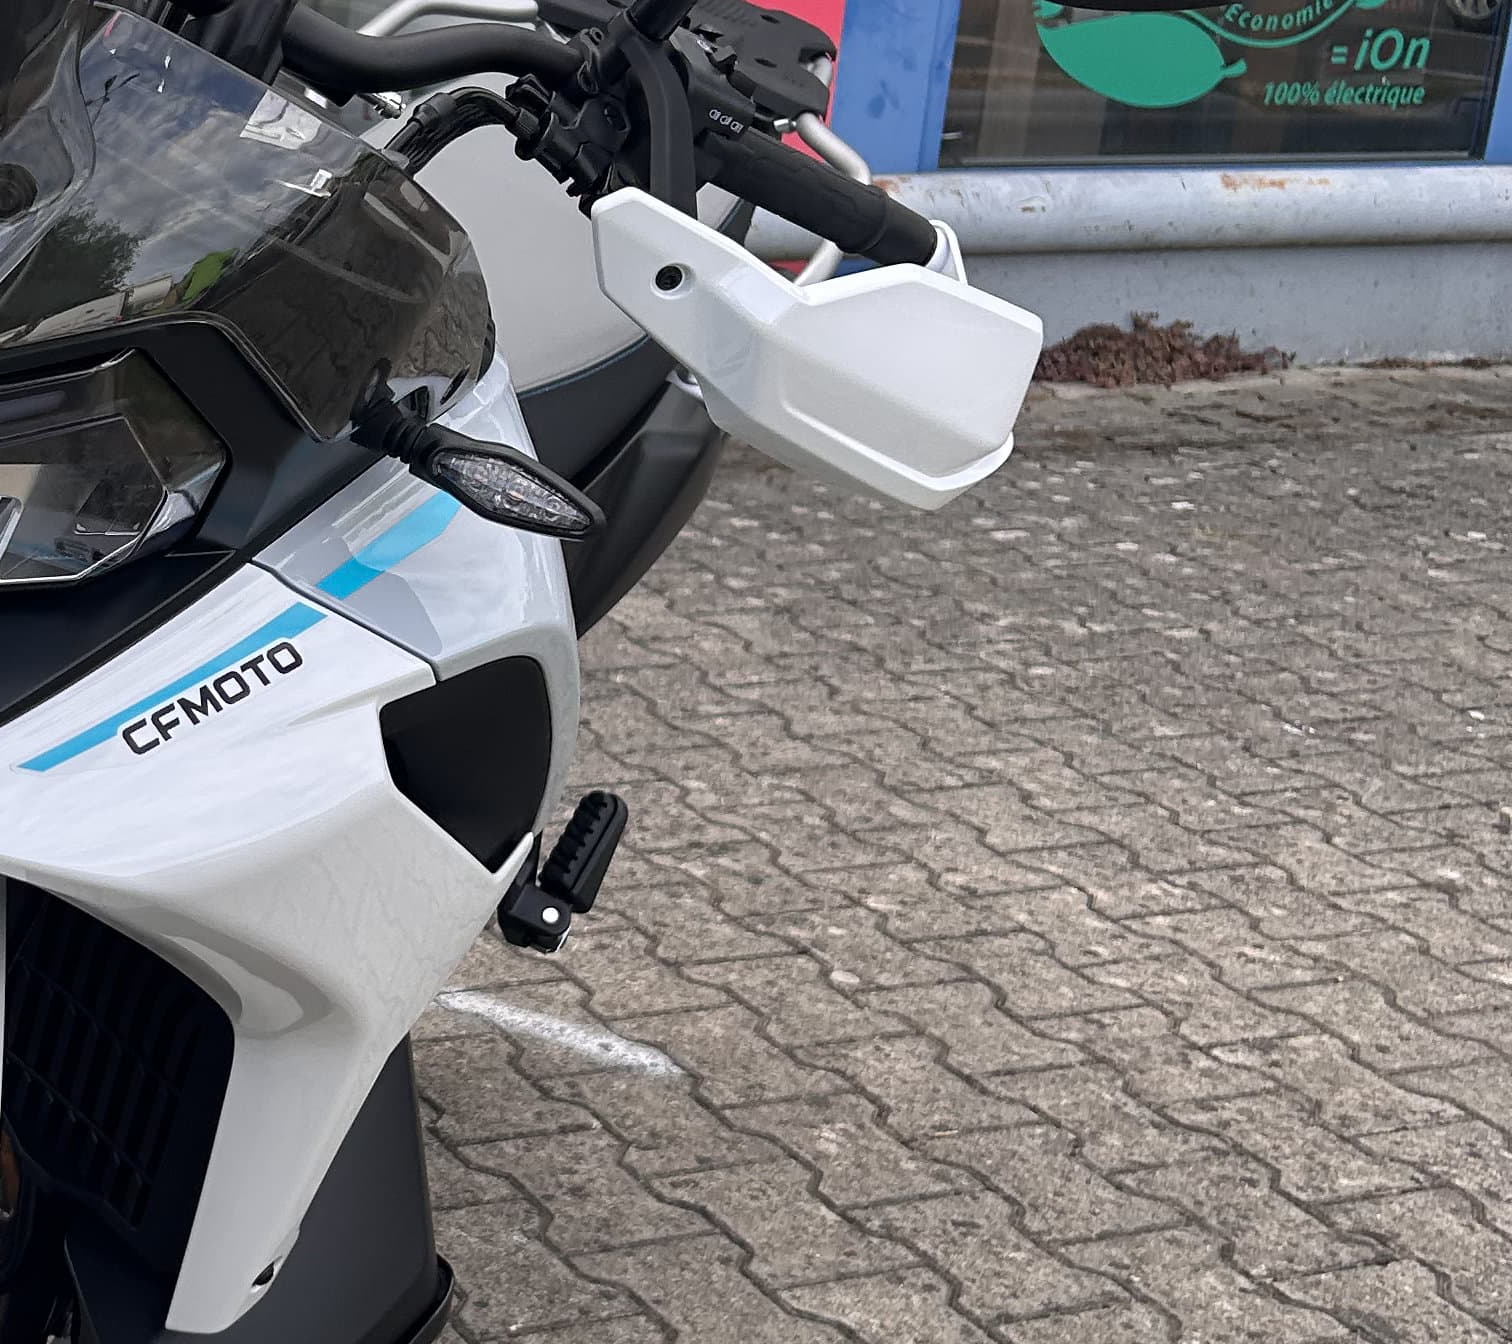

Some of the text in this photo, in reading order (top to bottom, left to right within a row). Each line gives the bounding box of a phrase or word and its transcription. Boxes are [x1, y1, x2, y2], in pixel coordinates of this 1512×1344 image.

[1354, 28, 1431, 71] iOn
[1263, 79, 1426, 111] 100% électrique
[121, 641, 303, 756] CFMOTO
